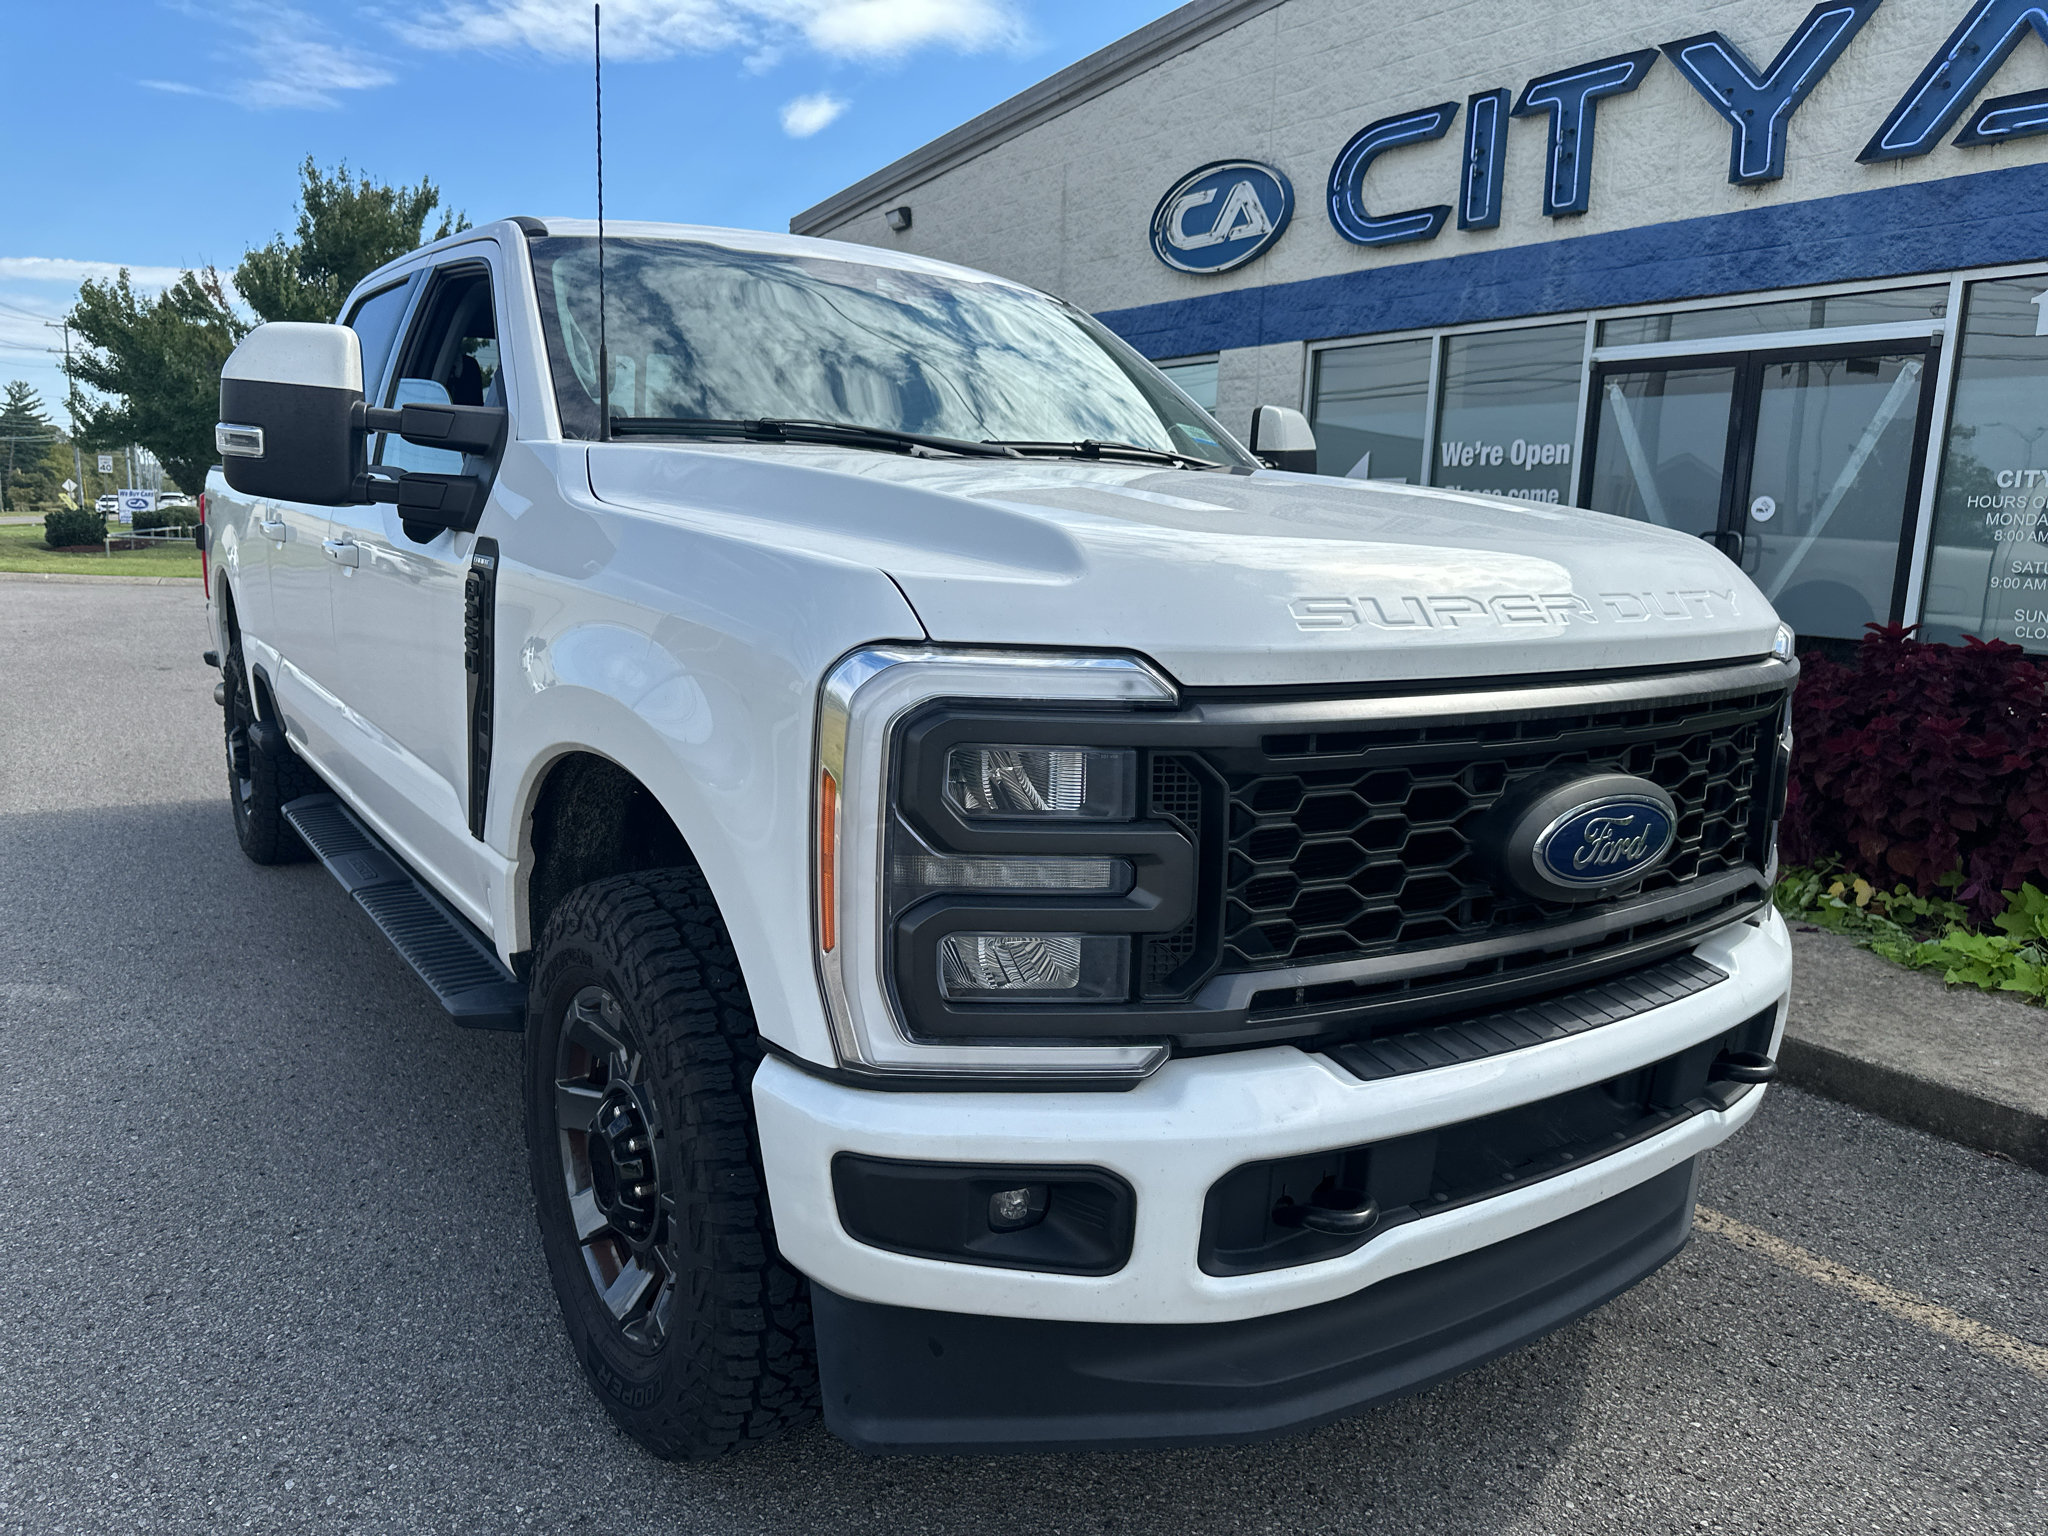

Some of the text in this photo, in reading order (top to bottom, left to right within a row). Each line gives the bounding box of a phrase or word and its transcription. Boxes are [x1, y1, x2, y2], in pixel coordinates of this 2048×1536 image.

[1166, 180, 1273, 250] CA
[1442, 438, 1571, 471] We're Open
[1967, 495, 2048, 509] HOURS O
[1994, 529, 2024, 542] 8:00
[1990, 576, 2047, 591] 9:00 AM
[1287, 588, 1741, 632] SUPER DUTY
[2015, 626, 2048, 640] CLO
[1572, 814, 1652, 871] Ford
